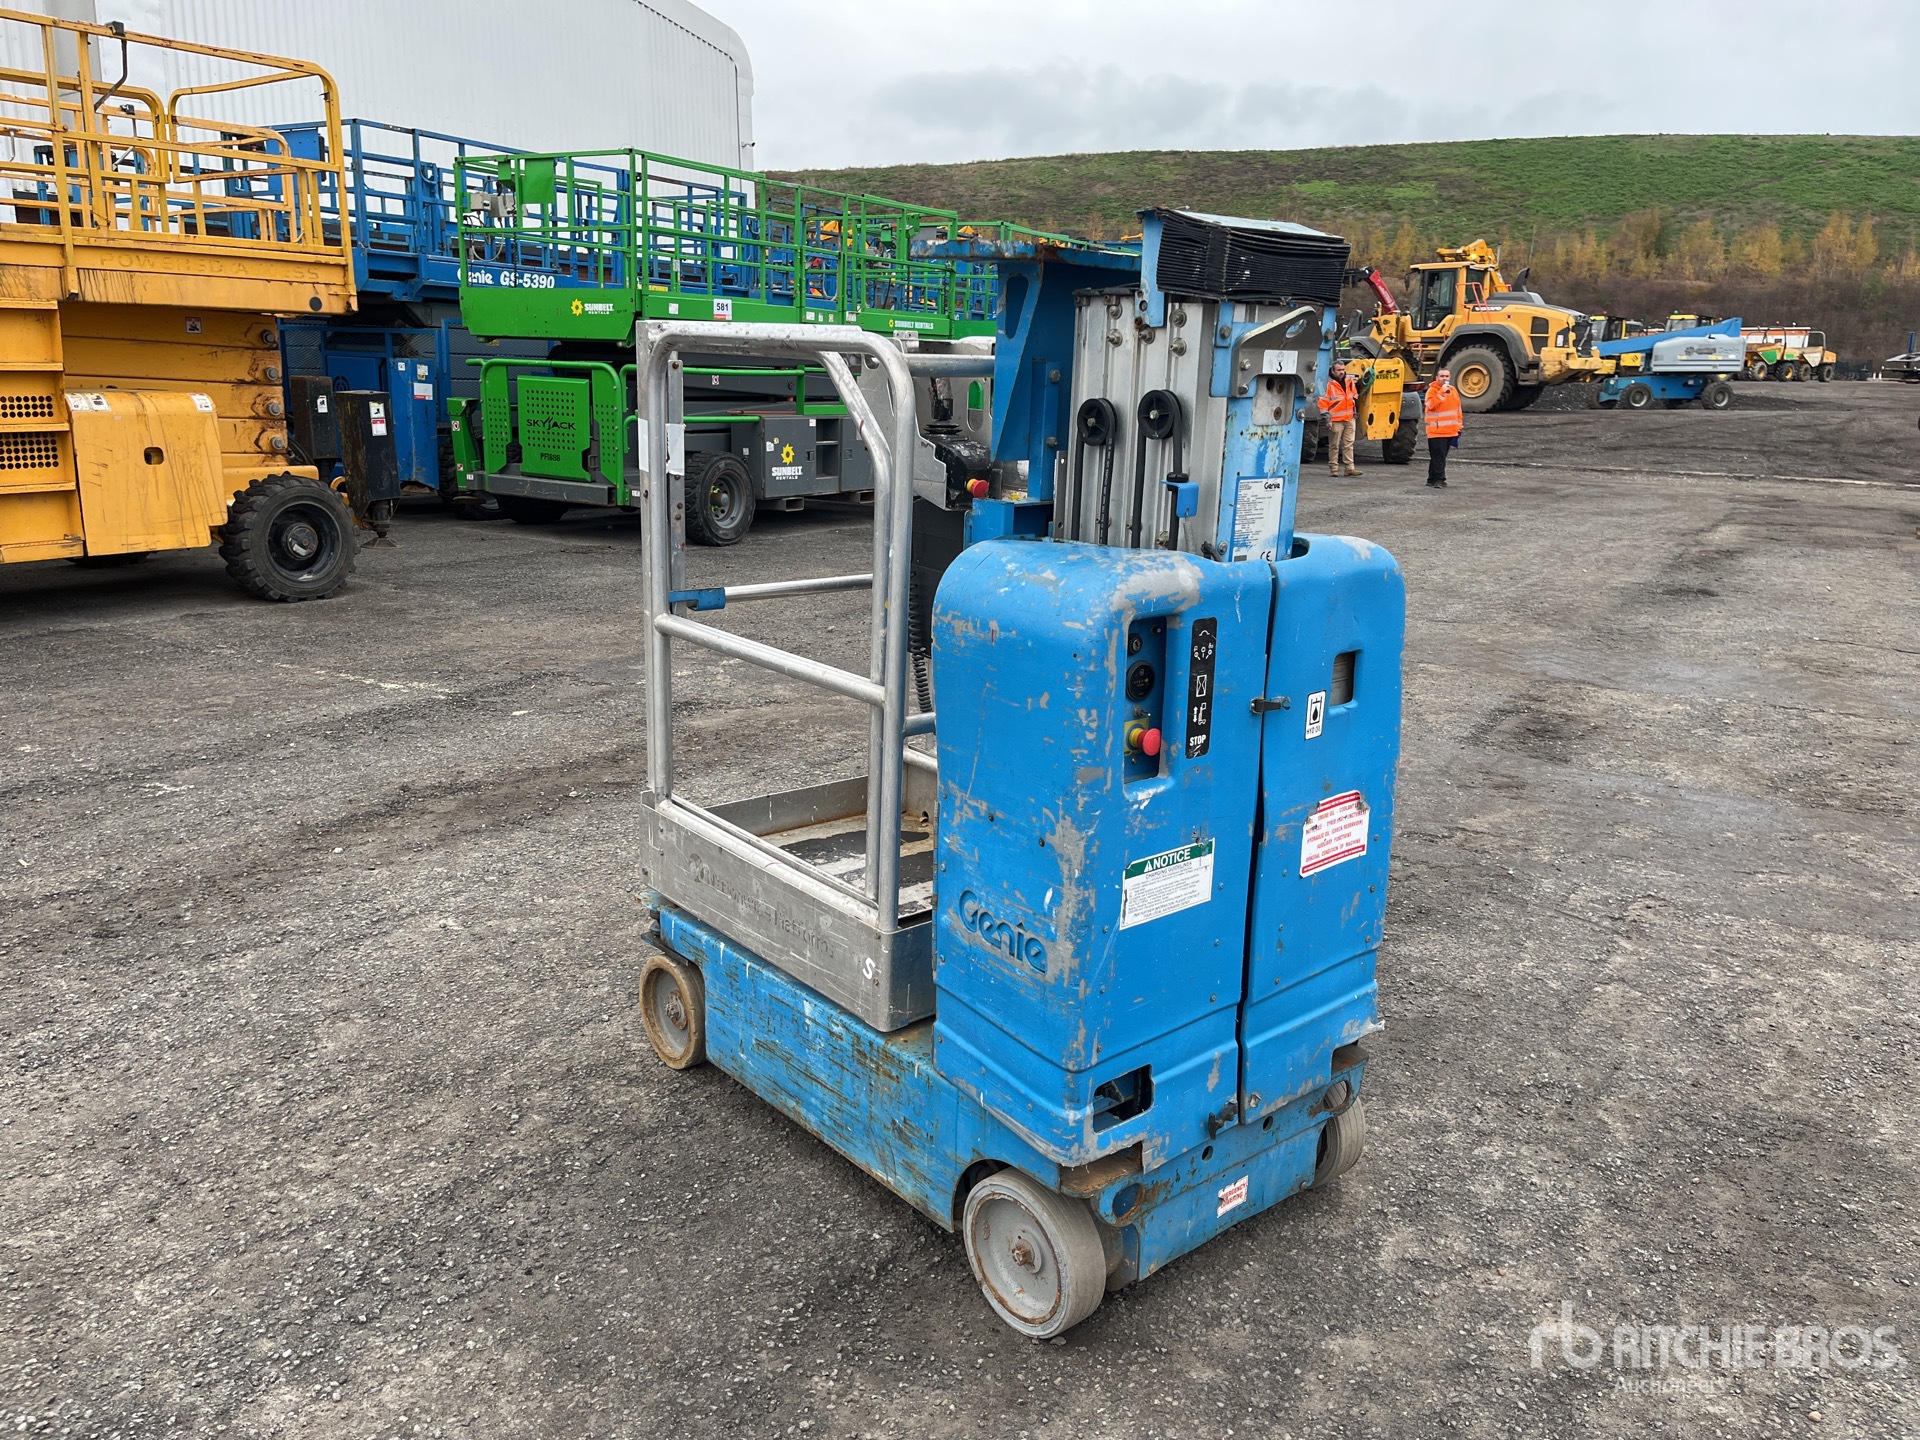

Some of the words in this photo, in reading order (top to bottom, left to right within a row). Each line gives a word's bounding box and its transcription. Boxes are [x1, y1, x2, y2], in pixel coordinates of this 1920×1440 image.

[584, 303, 614, 312] SUNBELT
[716, 302, 729, 311] 581
[526, 416, 576, 430] SKYJACK
[771, 466, 803, 477] SUNBELT
[1306, 727, 1315, 735] HYD
[1189, 734, 1207, 746] STOP
[1153, 848, 1191, 870] NOTICE
[959, 890, 1047, 974] Genie
